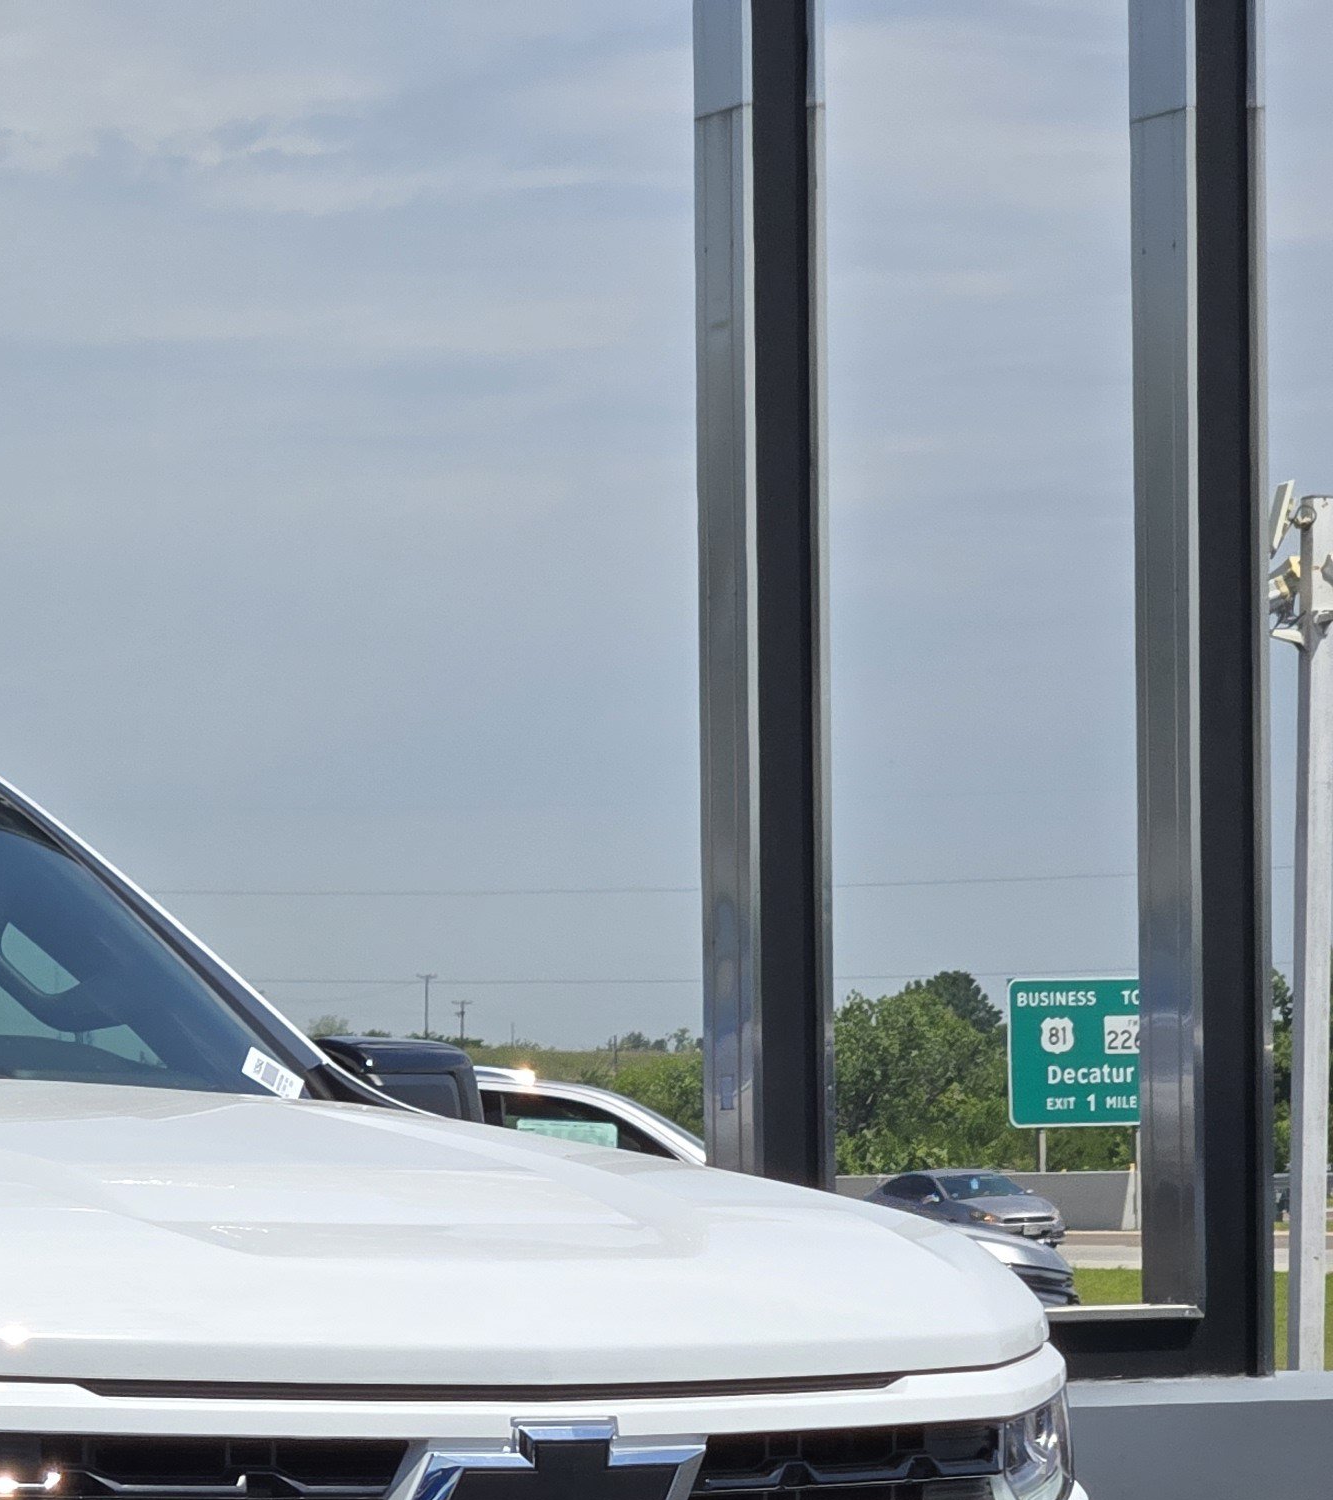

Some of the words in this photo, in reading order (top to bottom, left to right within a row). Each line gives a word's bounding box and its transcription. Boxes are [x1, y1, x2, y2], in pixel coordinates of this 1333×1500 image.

[1016, 990, 1097, 1008] BUSINESS
[1048, 1026, 1068, 1046] 81
[1047, 1064, 1135, 1084] Decatur
[1046, 1096, 1076, 1111] EXIT
[1086, 1093, 1097, 1112] 1
[1105, 1095, 1138, 1110] MILE
